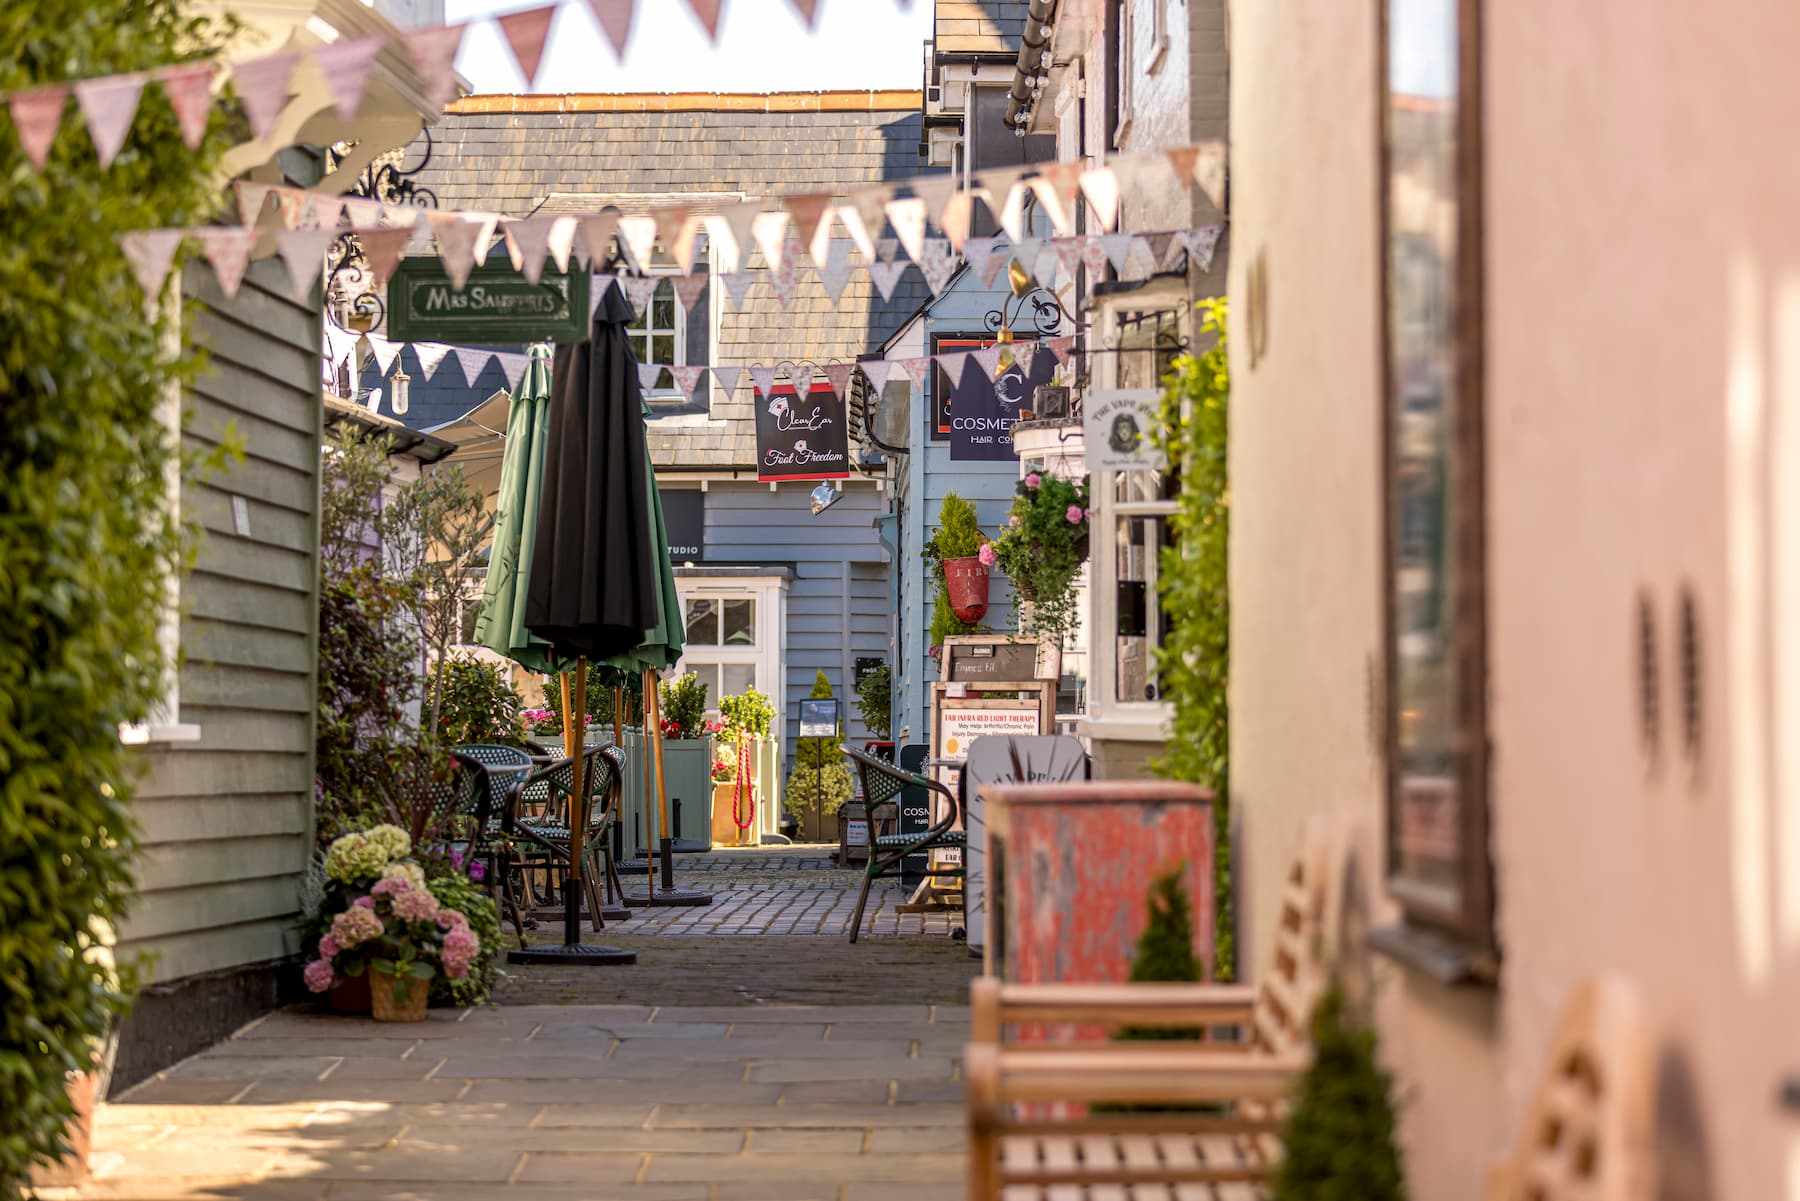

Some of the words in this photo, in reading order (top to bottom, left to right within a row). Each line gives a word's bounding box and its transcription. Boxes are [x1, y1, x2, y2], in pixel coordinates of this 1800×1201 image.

[795, 448, 844, 465] Freedom
[667, 546, 698, 554] TUDIO
[1009, 715, 1036, 723] THERAPY
[904, 808, 930, 816] COSM
